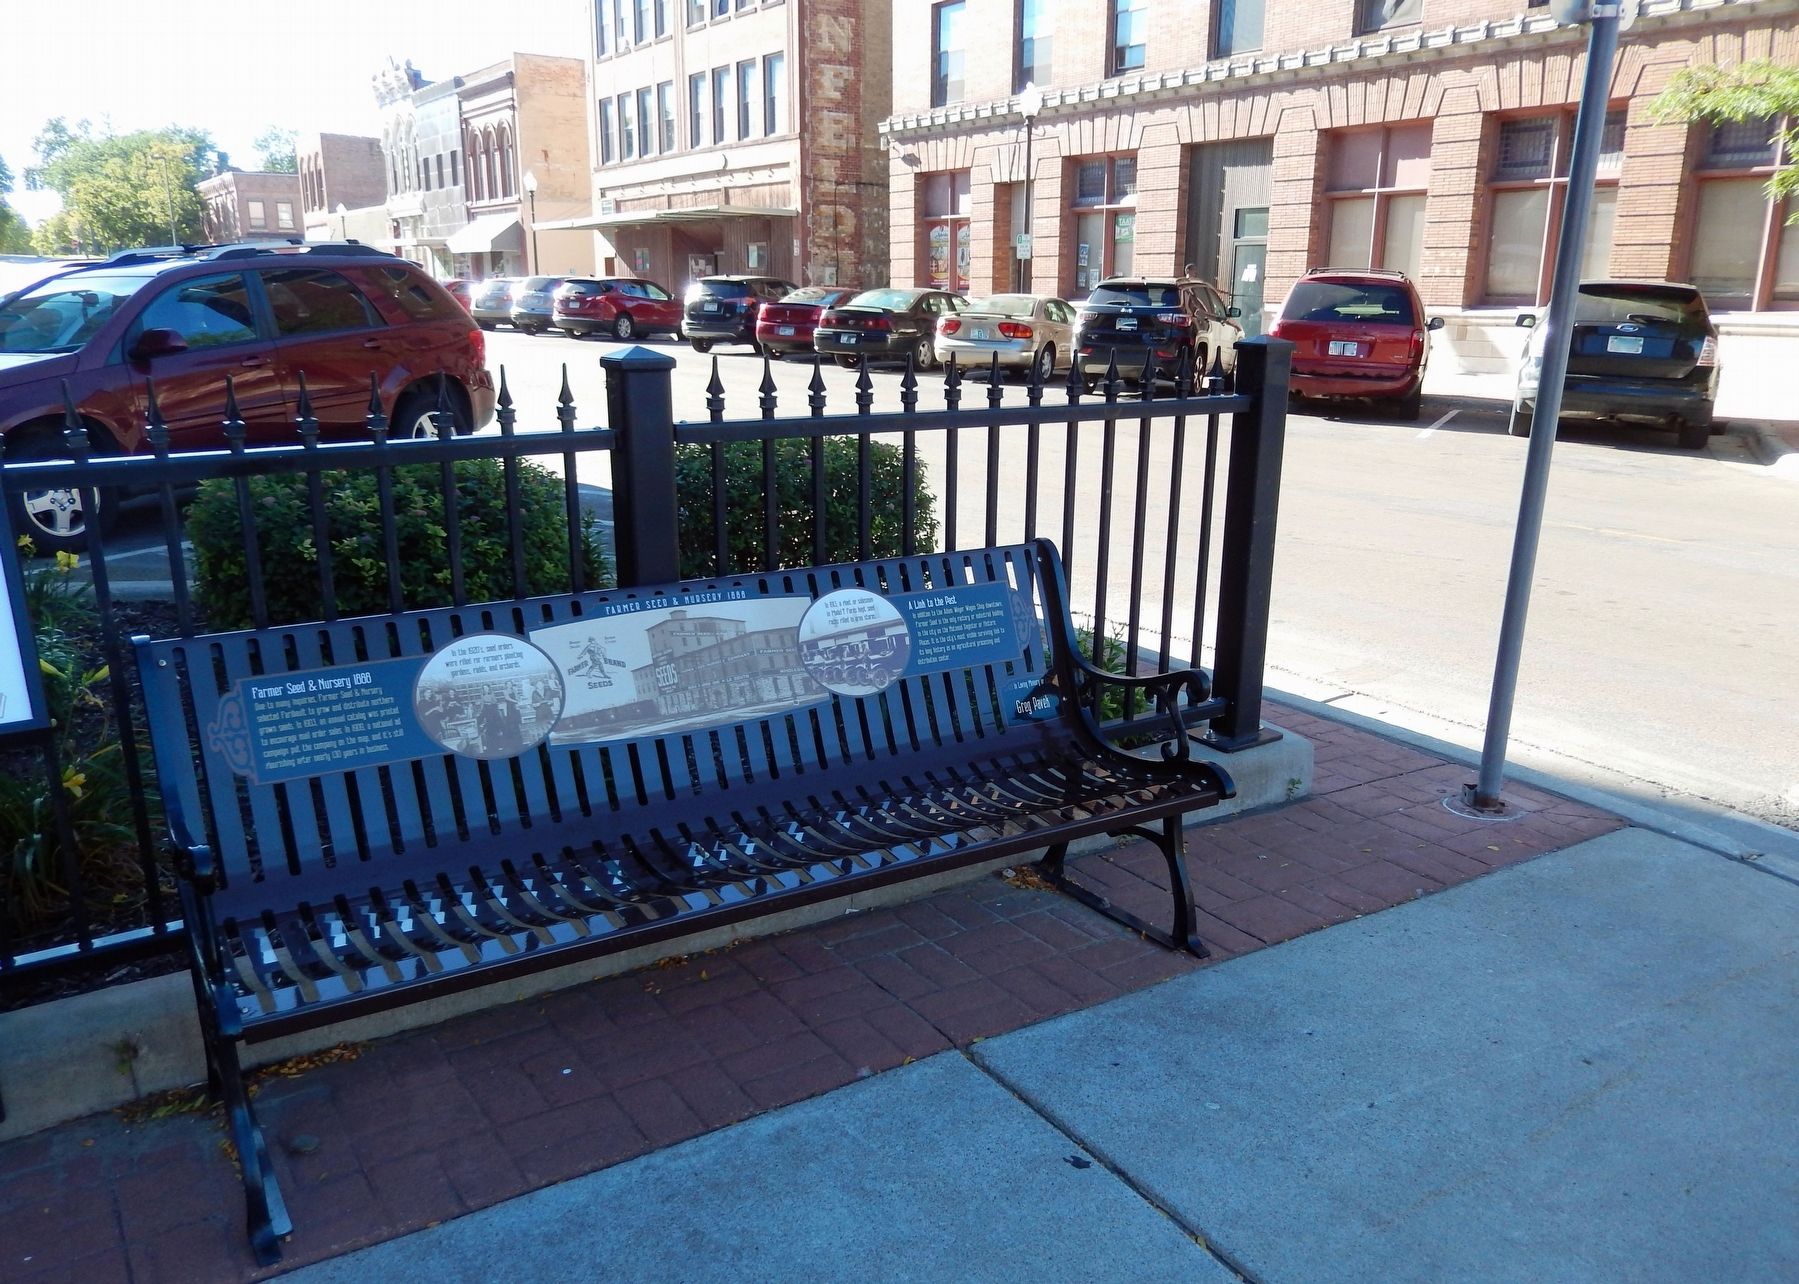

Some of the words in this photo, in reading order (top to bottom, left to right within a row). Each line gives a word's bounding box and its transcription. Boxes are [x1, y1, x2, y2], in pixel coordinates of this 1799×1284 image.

[604, 603, 640, 614] FARMER
[646, 599, 668, 609] SEED
[673, 598, 679, 606] &
[684, 592, 722, 604] NURSERY
[727, 590, 746, 599] 1888
[909, 601, 913, 610] A
[913, 599, 926, 610] Link
[927, 599, 934, 608] to
[934, 598, 944, 607] the
[945, 595, 957, 605] Past
[252, 687, 284, 699] Farmer
[287, 681, 306, 695] Seed
[309, 680, 317, 692] &
[318, 678, 352, 690] Nursery
[354, 672, 372, 685] 1888
[587, 679, 613, 689] SEEDS
[656, 663, 678, 688] SEEDS
[1015, 698, 1032, 714] Greg
